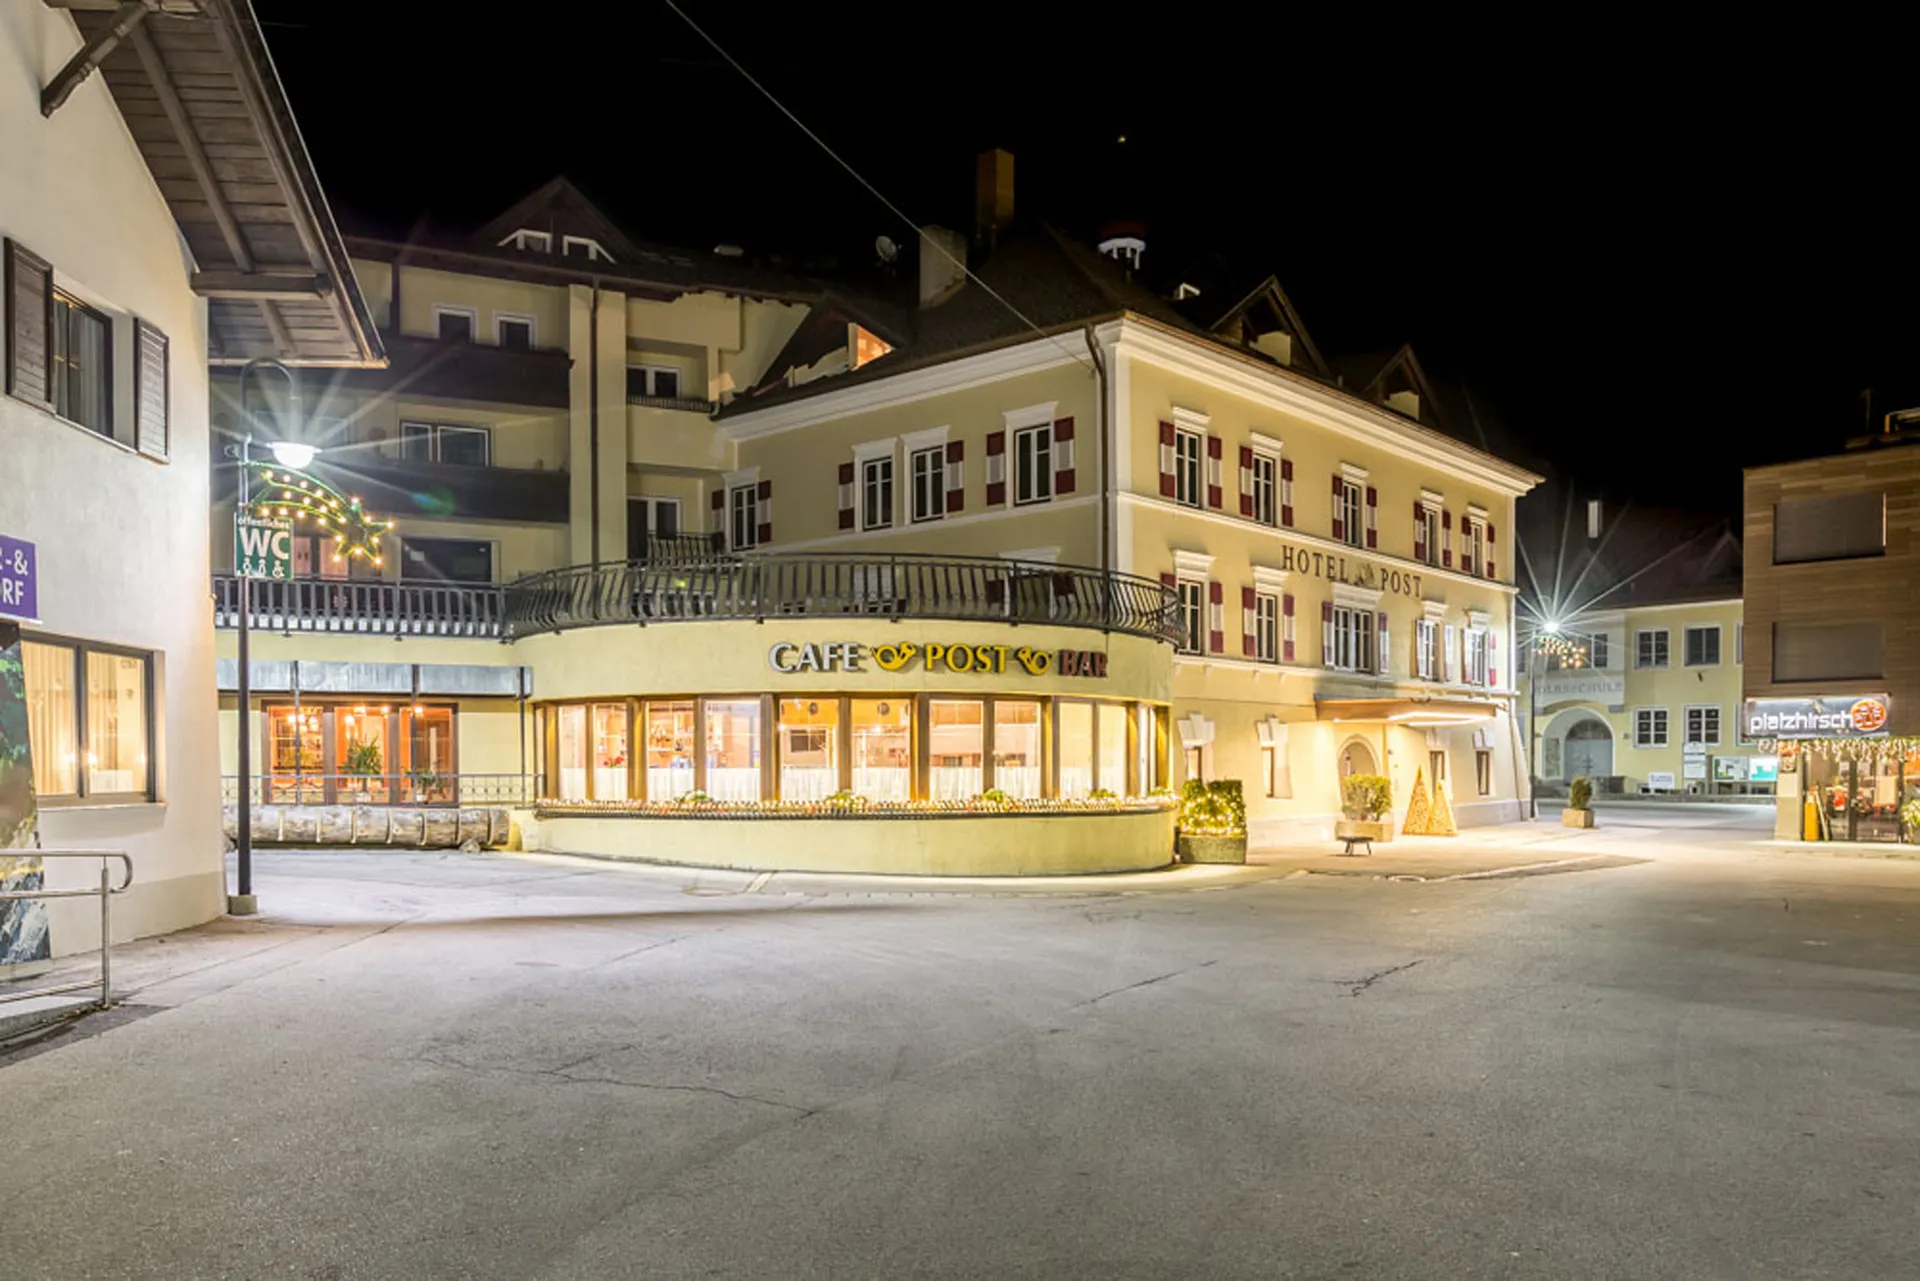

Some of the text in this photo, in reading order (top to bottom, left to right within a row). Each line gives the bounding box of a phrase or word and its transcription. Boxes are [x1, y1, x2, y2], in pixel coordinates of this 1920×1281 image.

[239, 526, 289, 560] WC
[1282, 545, 1421, 598] HOTEL POST
[0, 577, 24, 606] RF
[768, 641, 1108, 677] CAFE POST BAR
[1750, 710, 1854, 733] platzhirsch
